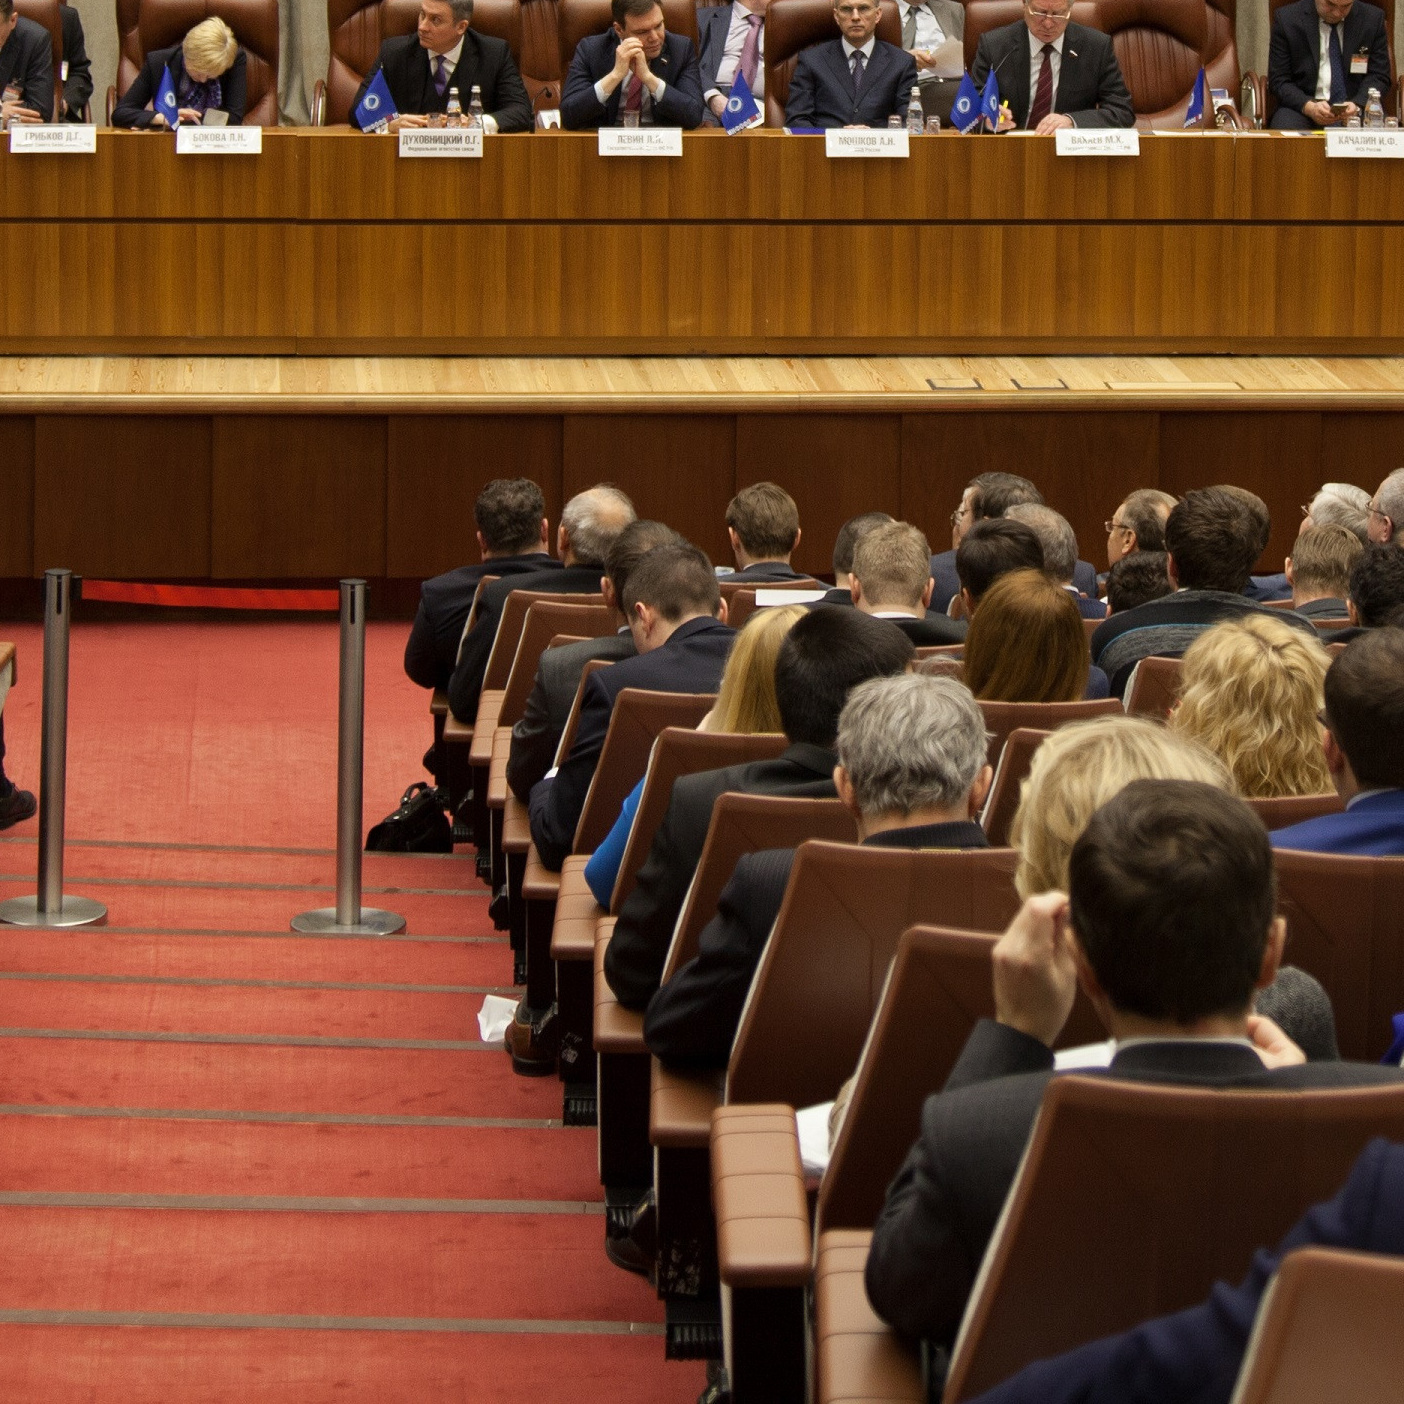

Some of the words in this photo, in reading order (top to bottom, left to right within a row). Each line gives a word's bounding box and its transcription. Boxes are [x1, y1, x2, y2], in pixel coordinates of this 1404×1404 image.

[25, 132, 63, 141] ГРИБКОВ
[193, 133, 226, 141] БОКОВА
[402, 134, 463, 145] ДУХОВНИЦКИЙ
[464, 135, 480, 144] О.Г.
[1338, 136, 1376, 145] КАЧАЛИН
[1379, 137, 1398, 146] И.Ф.
